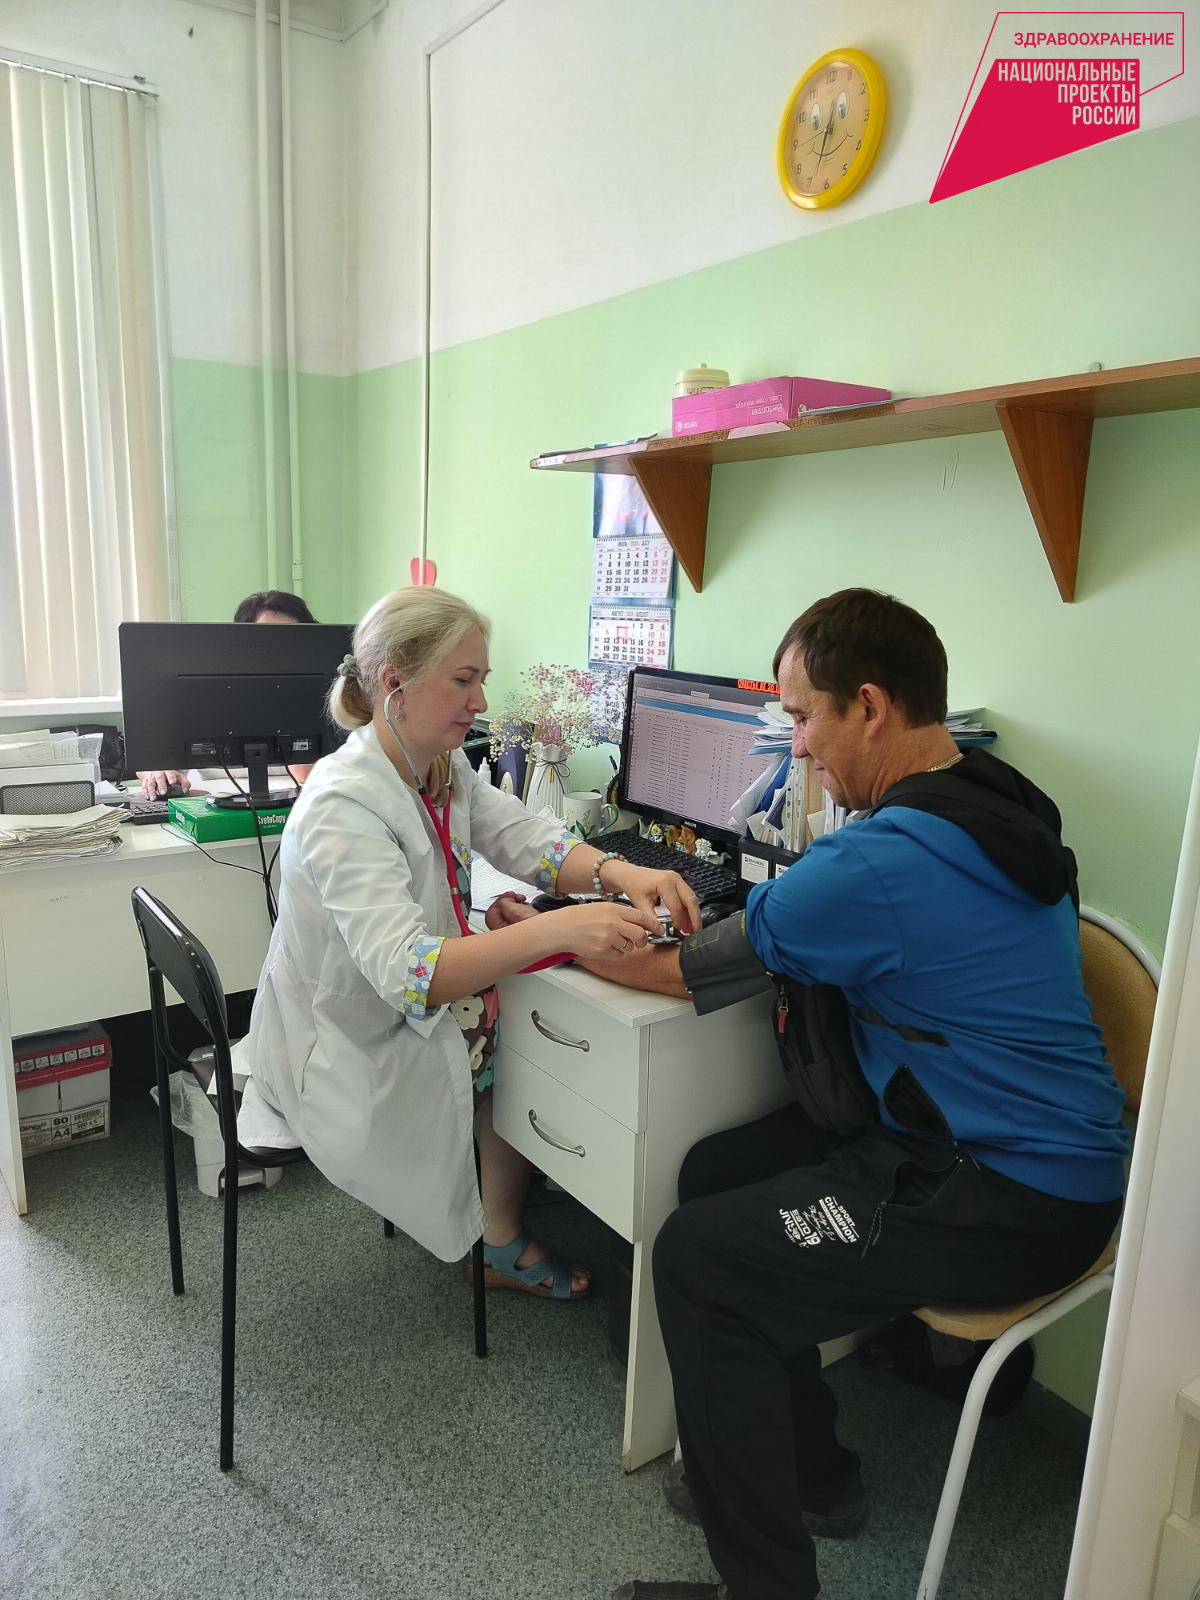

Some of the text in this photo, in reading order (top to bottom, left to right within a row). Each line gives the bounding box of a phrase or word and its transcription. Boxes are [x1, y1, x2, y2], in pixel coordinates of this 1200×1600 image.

[826, 70, 837, 85] 12
[858, 82, 866, 95] 2
[798, 112, 806, 125] 10
[864, 109, 870, 122] 3
[793, 139, 798, 151] 9
[796, 164, 802, 174] 8
[843, 163, 848, 176] 5
[807, 177, 812, 188] 7
[824, 178, 829, 190] 6
[751, 404, 782, 416] Performer
[53, 1117, 68, 1125] 80
[53, 1128, 70, 1139] A4
[824, 1196, 857, 1243] CHAMPION
[838, 1206, 855, 1227] SPORT
[804, 1232, 821, 1245] 19
